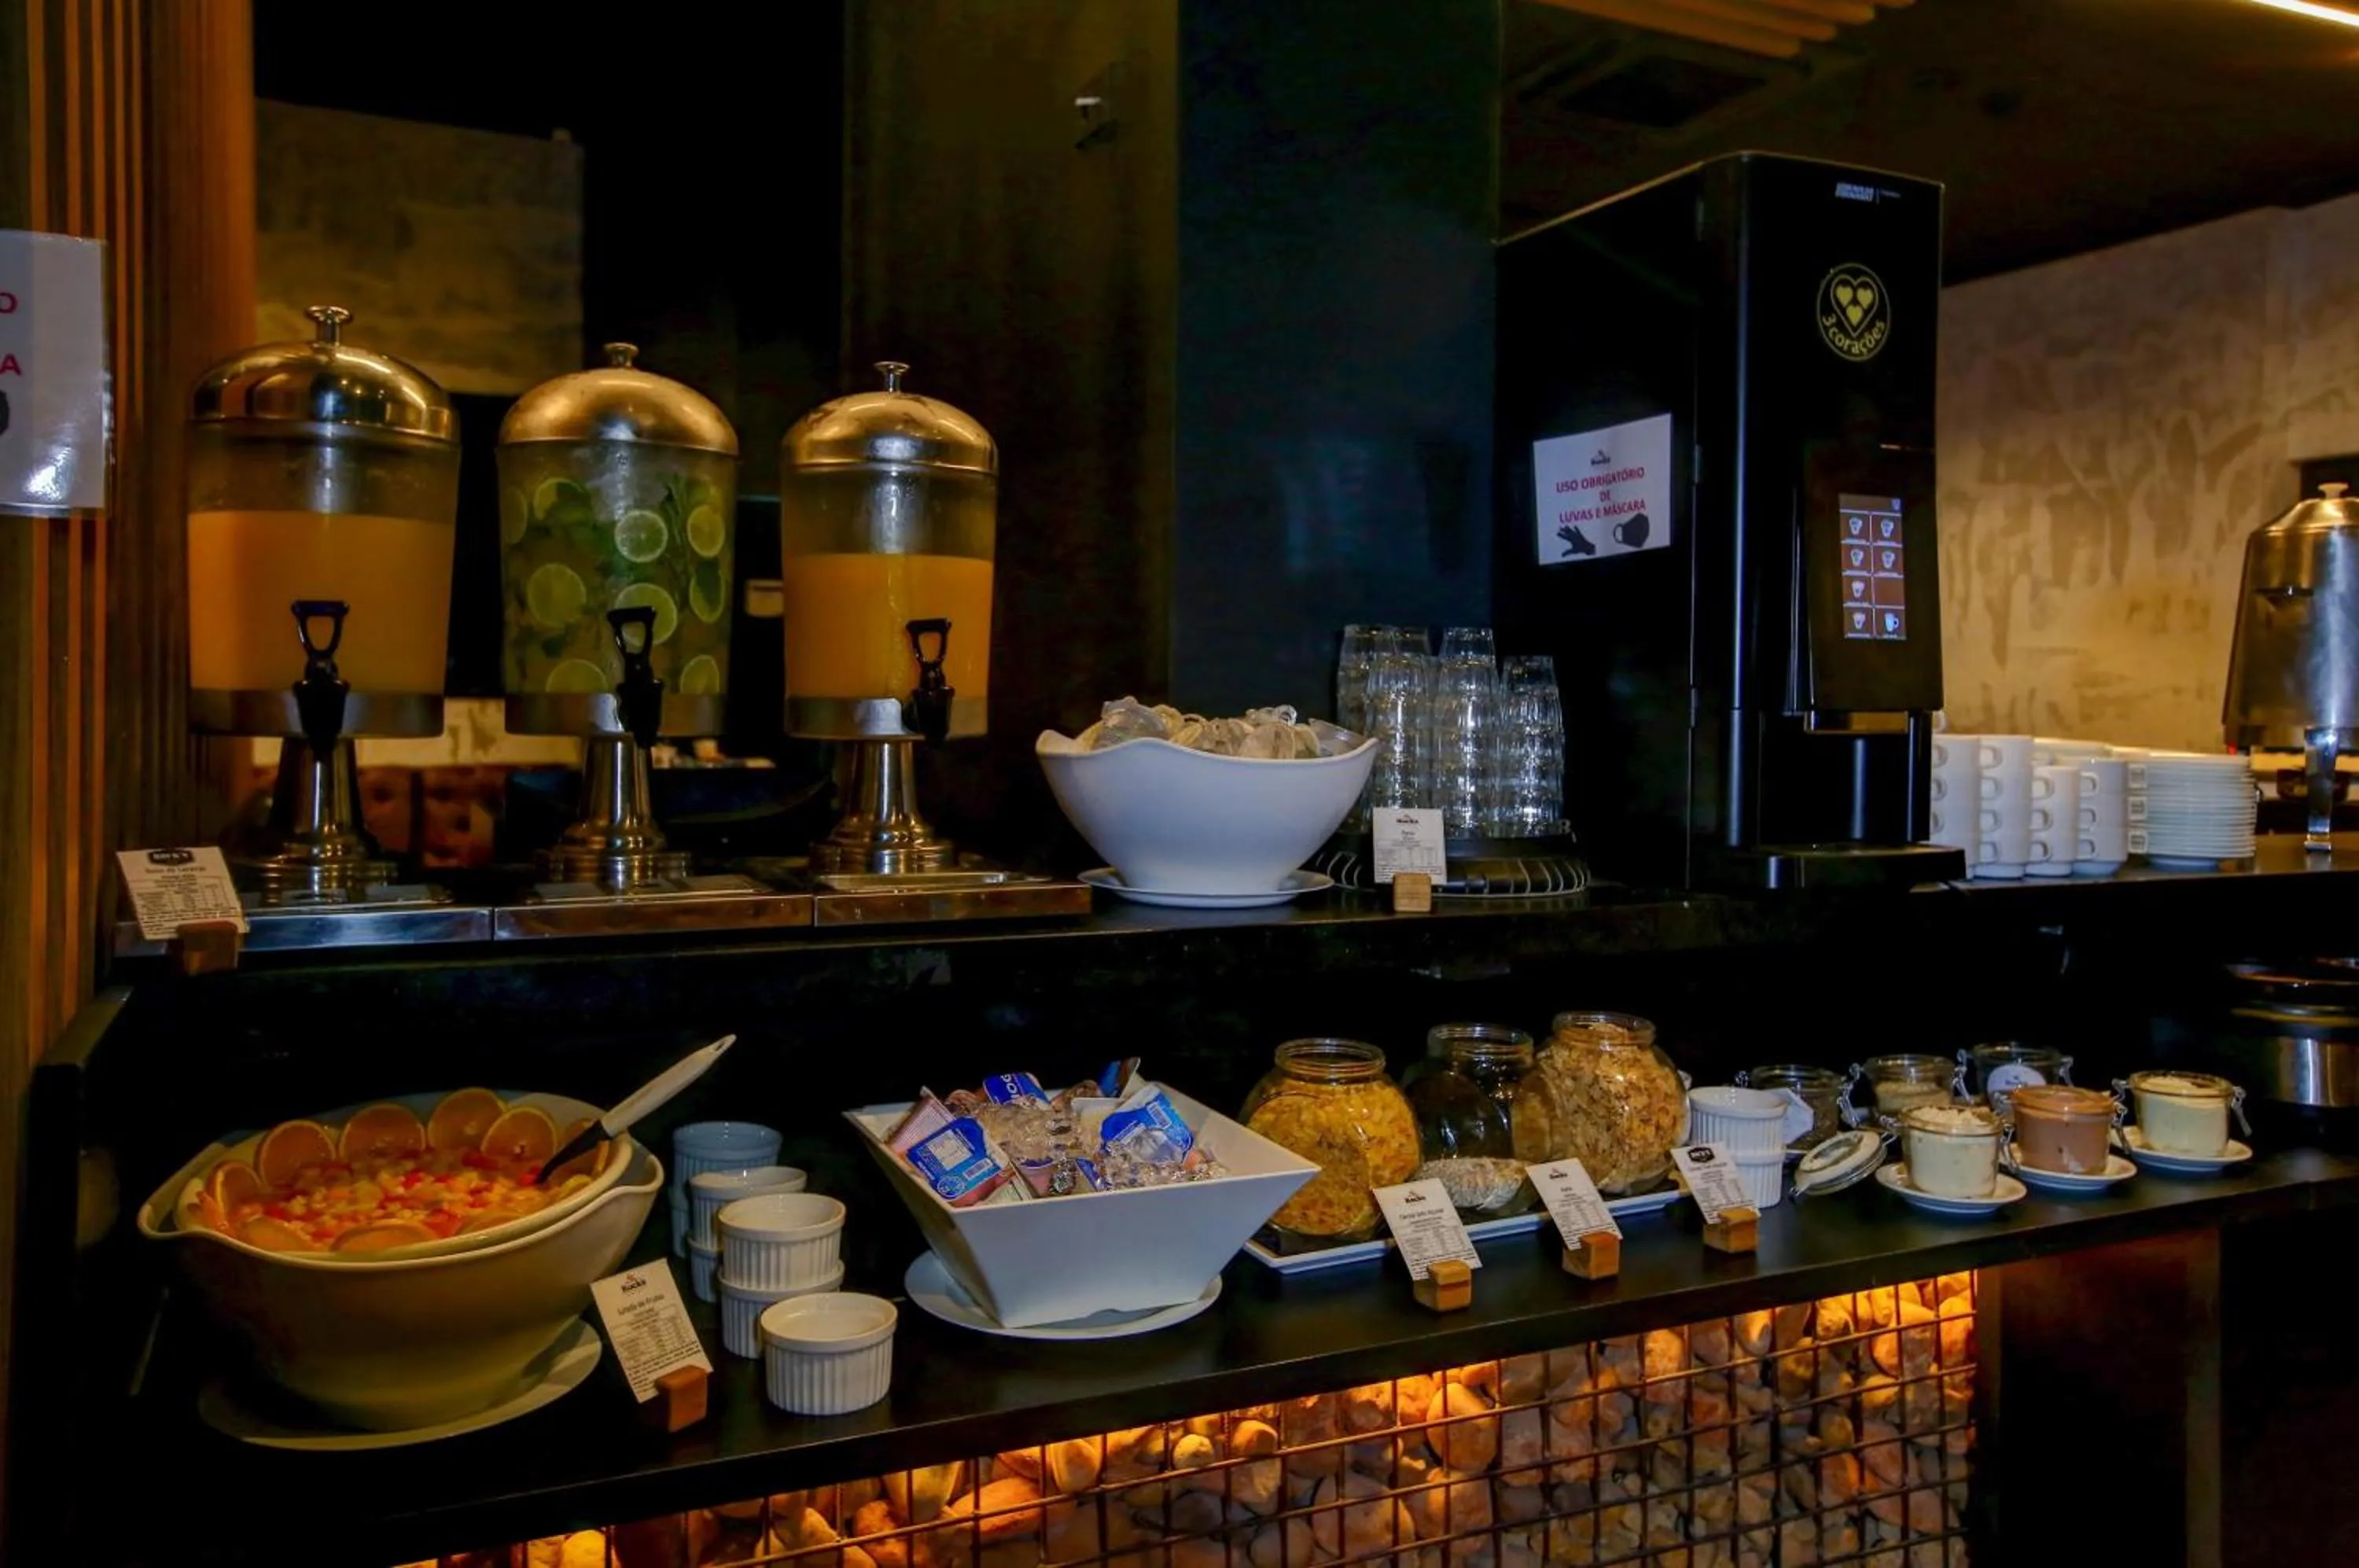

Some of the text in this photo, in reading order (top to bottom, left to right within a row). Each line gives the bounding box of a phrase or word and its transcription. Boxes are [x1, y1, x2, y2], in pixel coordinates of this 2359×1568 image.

[1829, 321, 1885, 355] corações
[1556, 467, 1644, 493] USO OBRIGATÓRIO
[1599, 490, 1610, 502] DE
[1559, 499, 1646, 524] LUVAS E MÁSCARA
